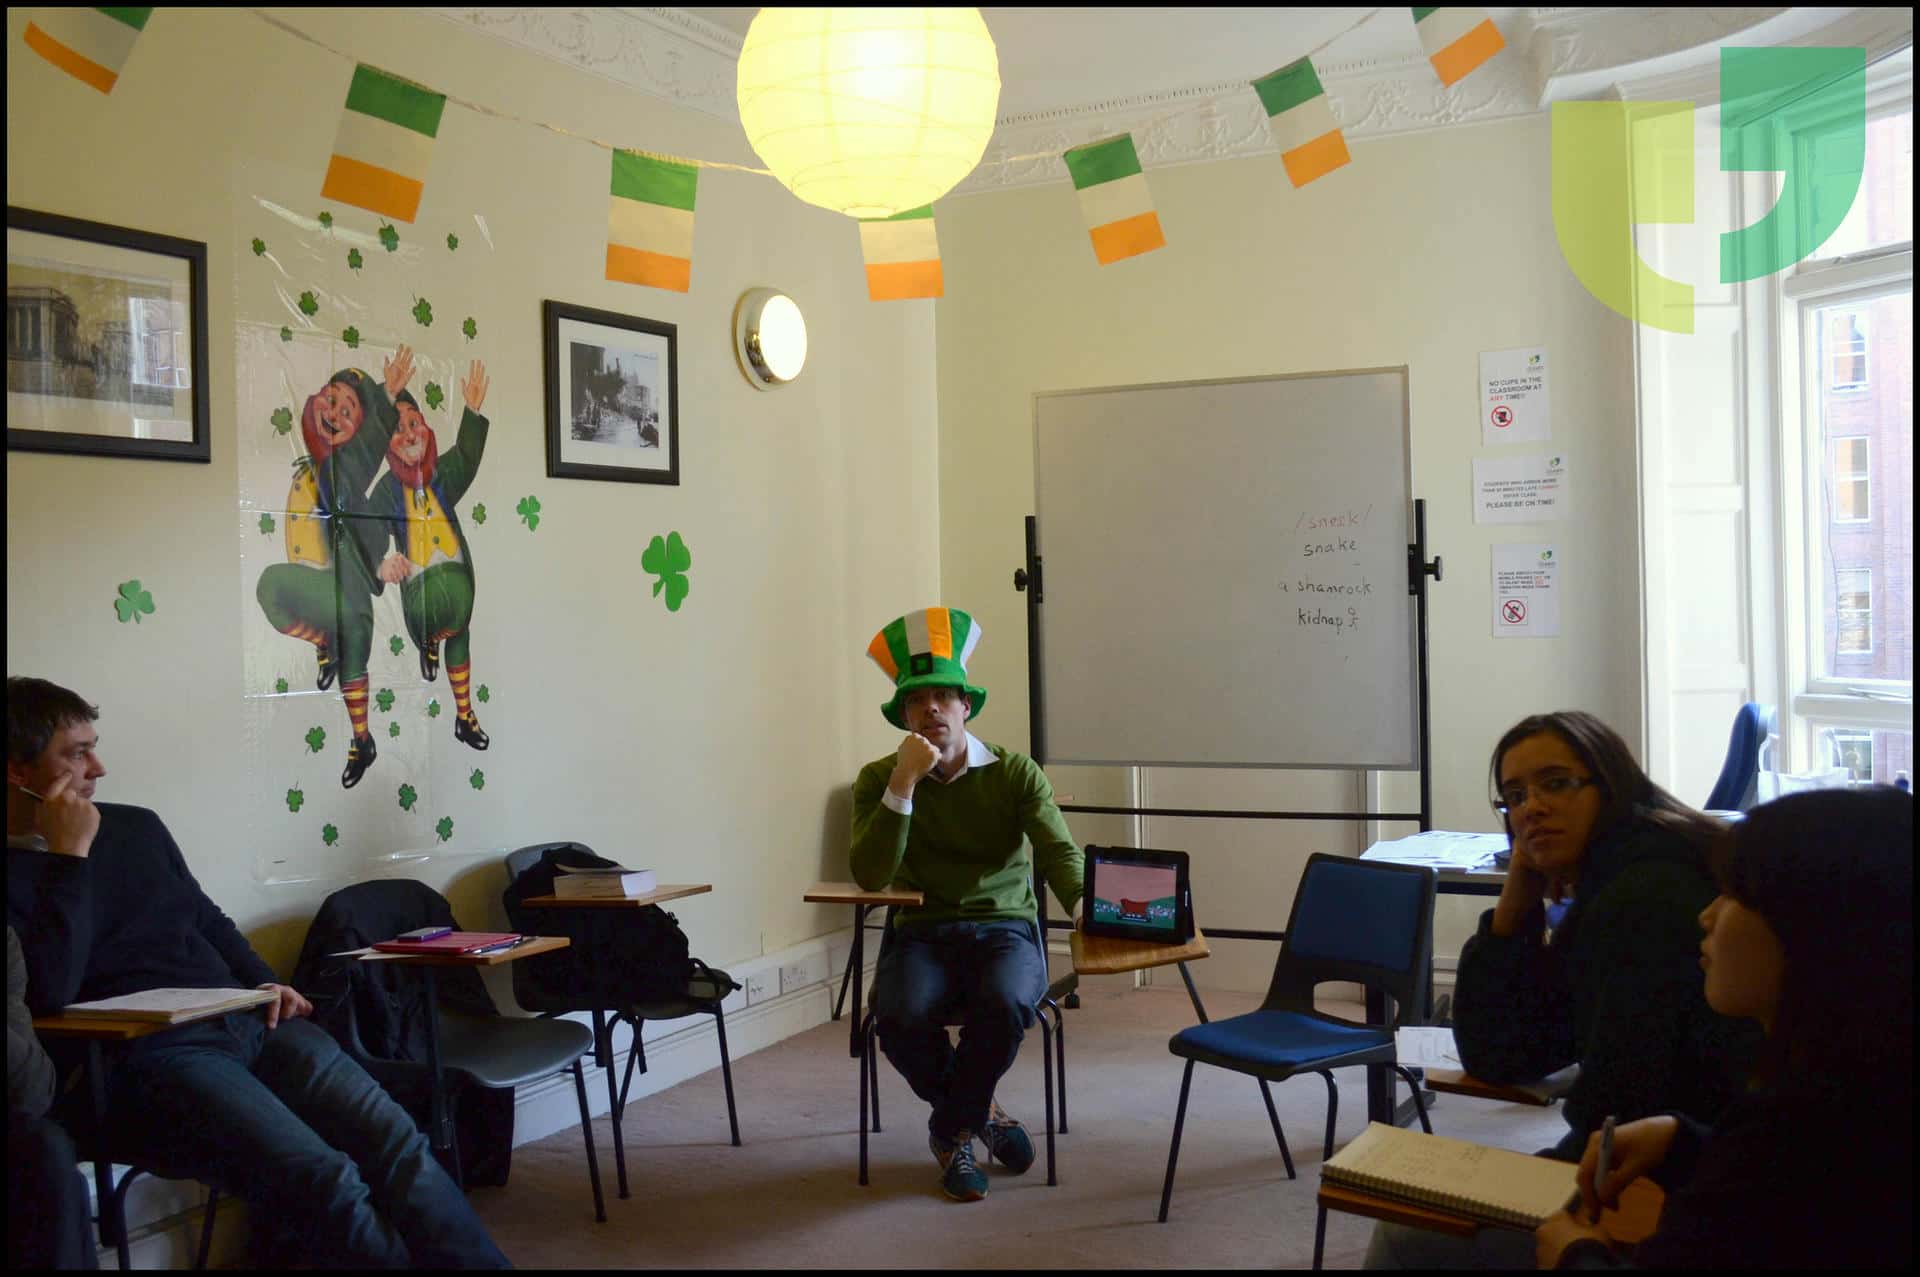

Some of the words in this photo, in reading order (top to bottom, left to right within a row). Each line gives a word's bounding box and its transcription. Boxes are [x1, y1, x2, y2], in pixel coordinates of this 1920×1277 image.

[1489, 385, 1531, 393] CLASSROOM
[1486, 501, 1512, 509] PLEASE
[1303, 536, 1358, 557] snake
[1297, 572, 1372, 597] shamrock
[1298, 606, 1344, 635] kidnap
